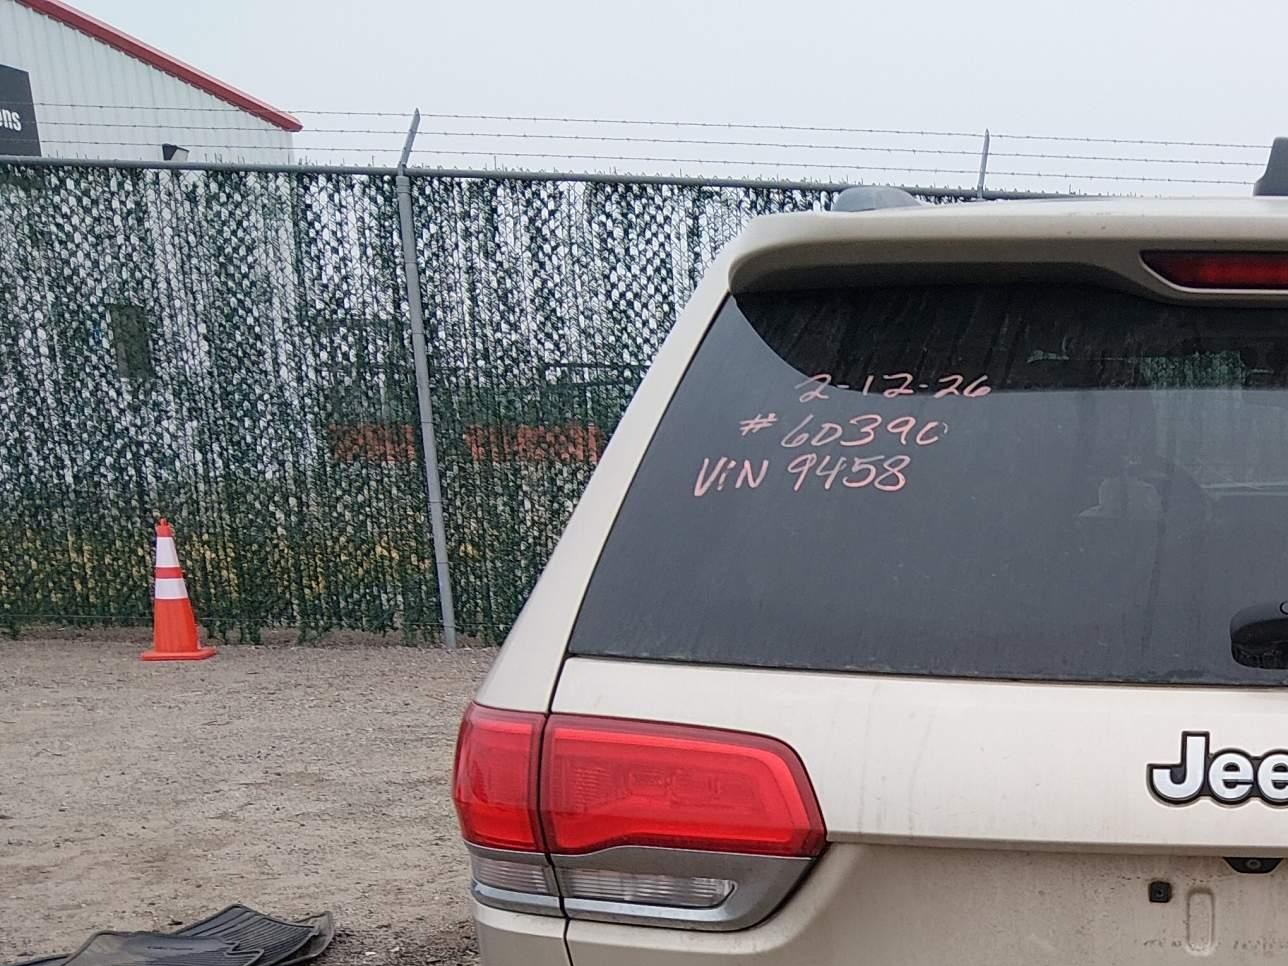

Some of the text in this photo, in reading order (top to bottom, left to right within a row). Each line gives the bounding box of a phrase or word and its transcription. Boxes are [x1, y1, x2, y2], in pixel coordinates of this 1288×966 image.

[794, 373, 992, 402] 2-12-26
[739, 412, 778, 436] #
[787, 453, 911, 491] 9458
